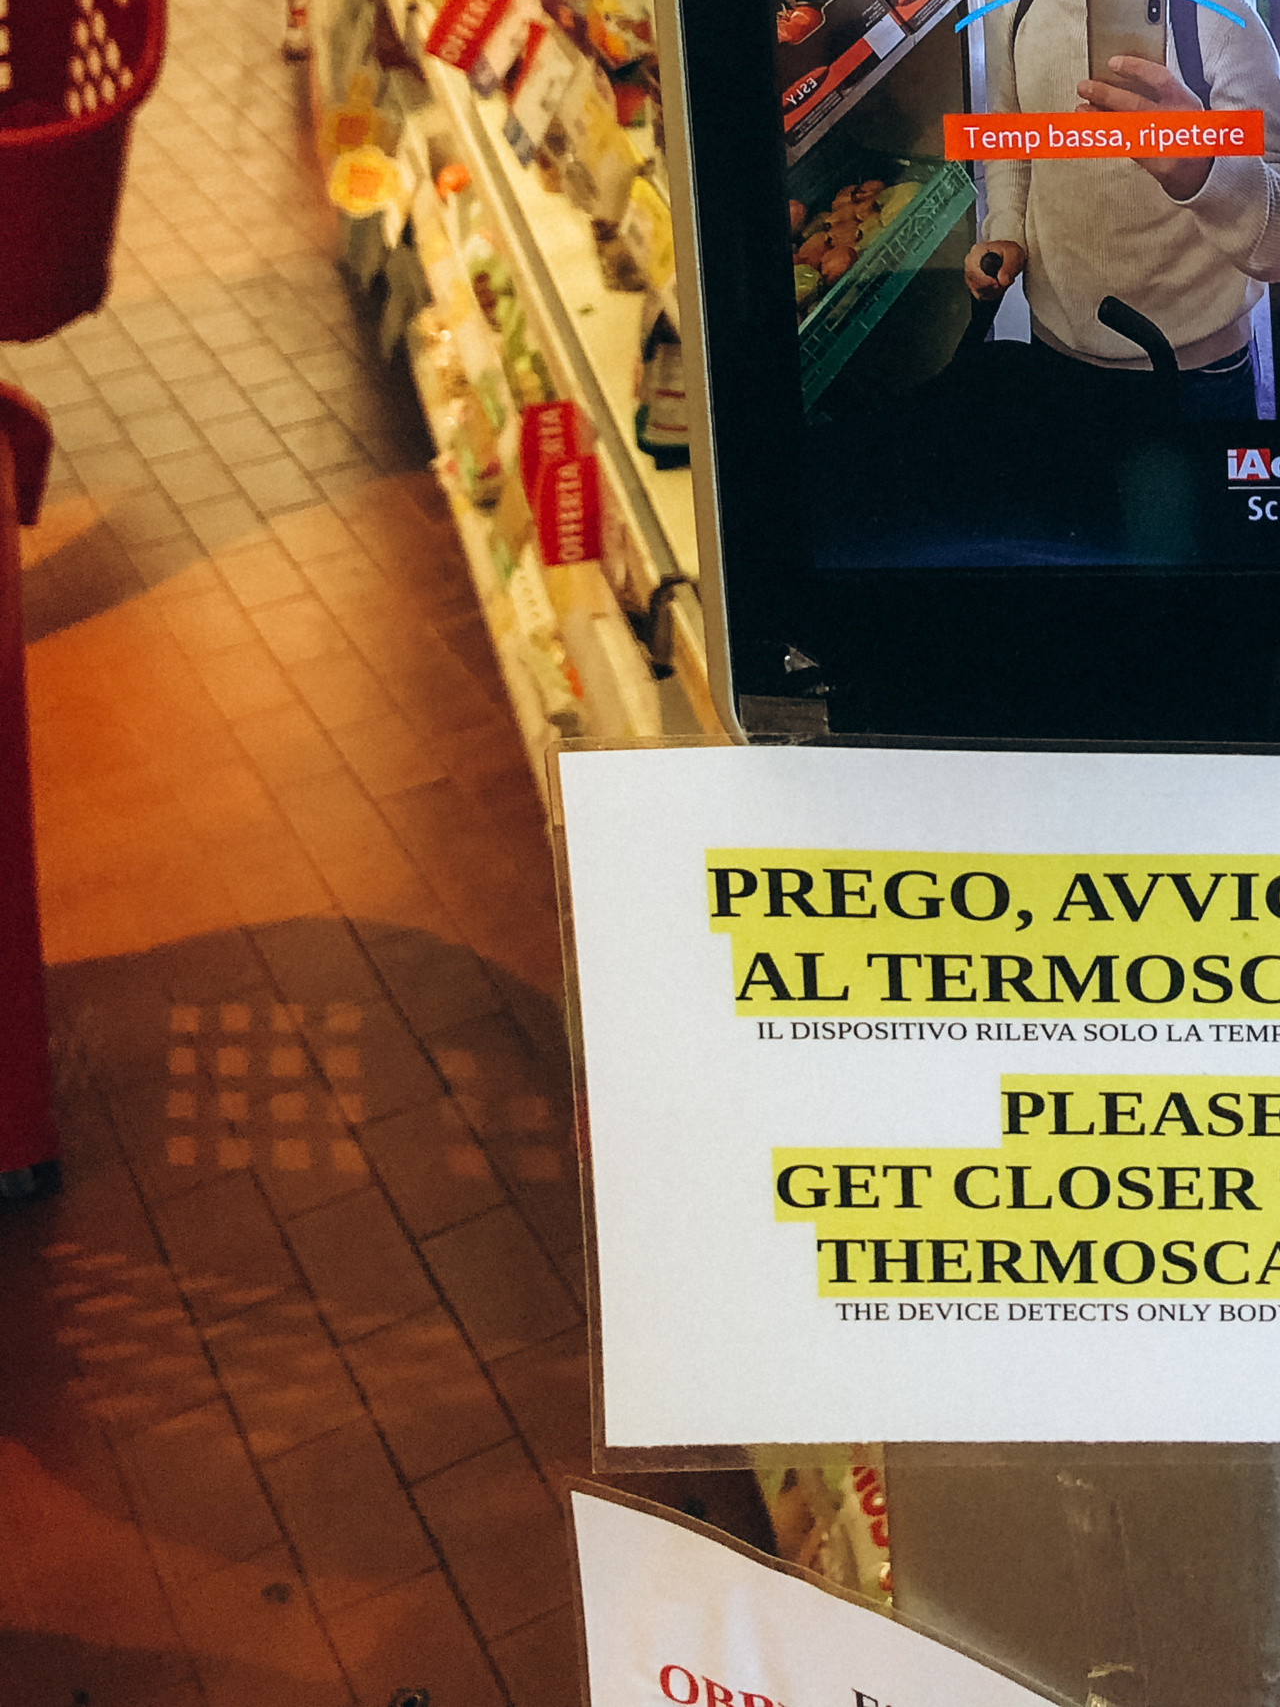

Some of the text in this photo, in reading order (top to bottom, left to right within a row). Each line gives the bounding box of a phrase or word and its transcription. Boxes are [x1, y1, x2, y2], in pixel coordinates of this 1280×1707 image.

[963, 123, 1244, 153] Temp bassa, ripetere
[708, 868, 1032, 931] PREGO,
[736, 953, 849, 1001] AL
[759, 1023, 782, 1039] IL
[792, 1023, 967, 1040] DISPOSITIVO
[977, 1024, 1075, 1040] RILEVA
[1085, 1024, 1157, 1041] SOLO
[1168, 1025, 1202, 1041] LA
[777, 1165, 931, 1208] GET
[954, 1166, 1262, 1210] CLOSER
[837, 1304, 889, 1320] THE
[900, 1304, 998, 1320] DEVICE
[1010, 1304, 1128, 1320] DETECTS
[1138, 1305, 1209, 1321] ONLY
